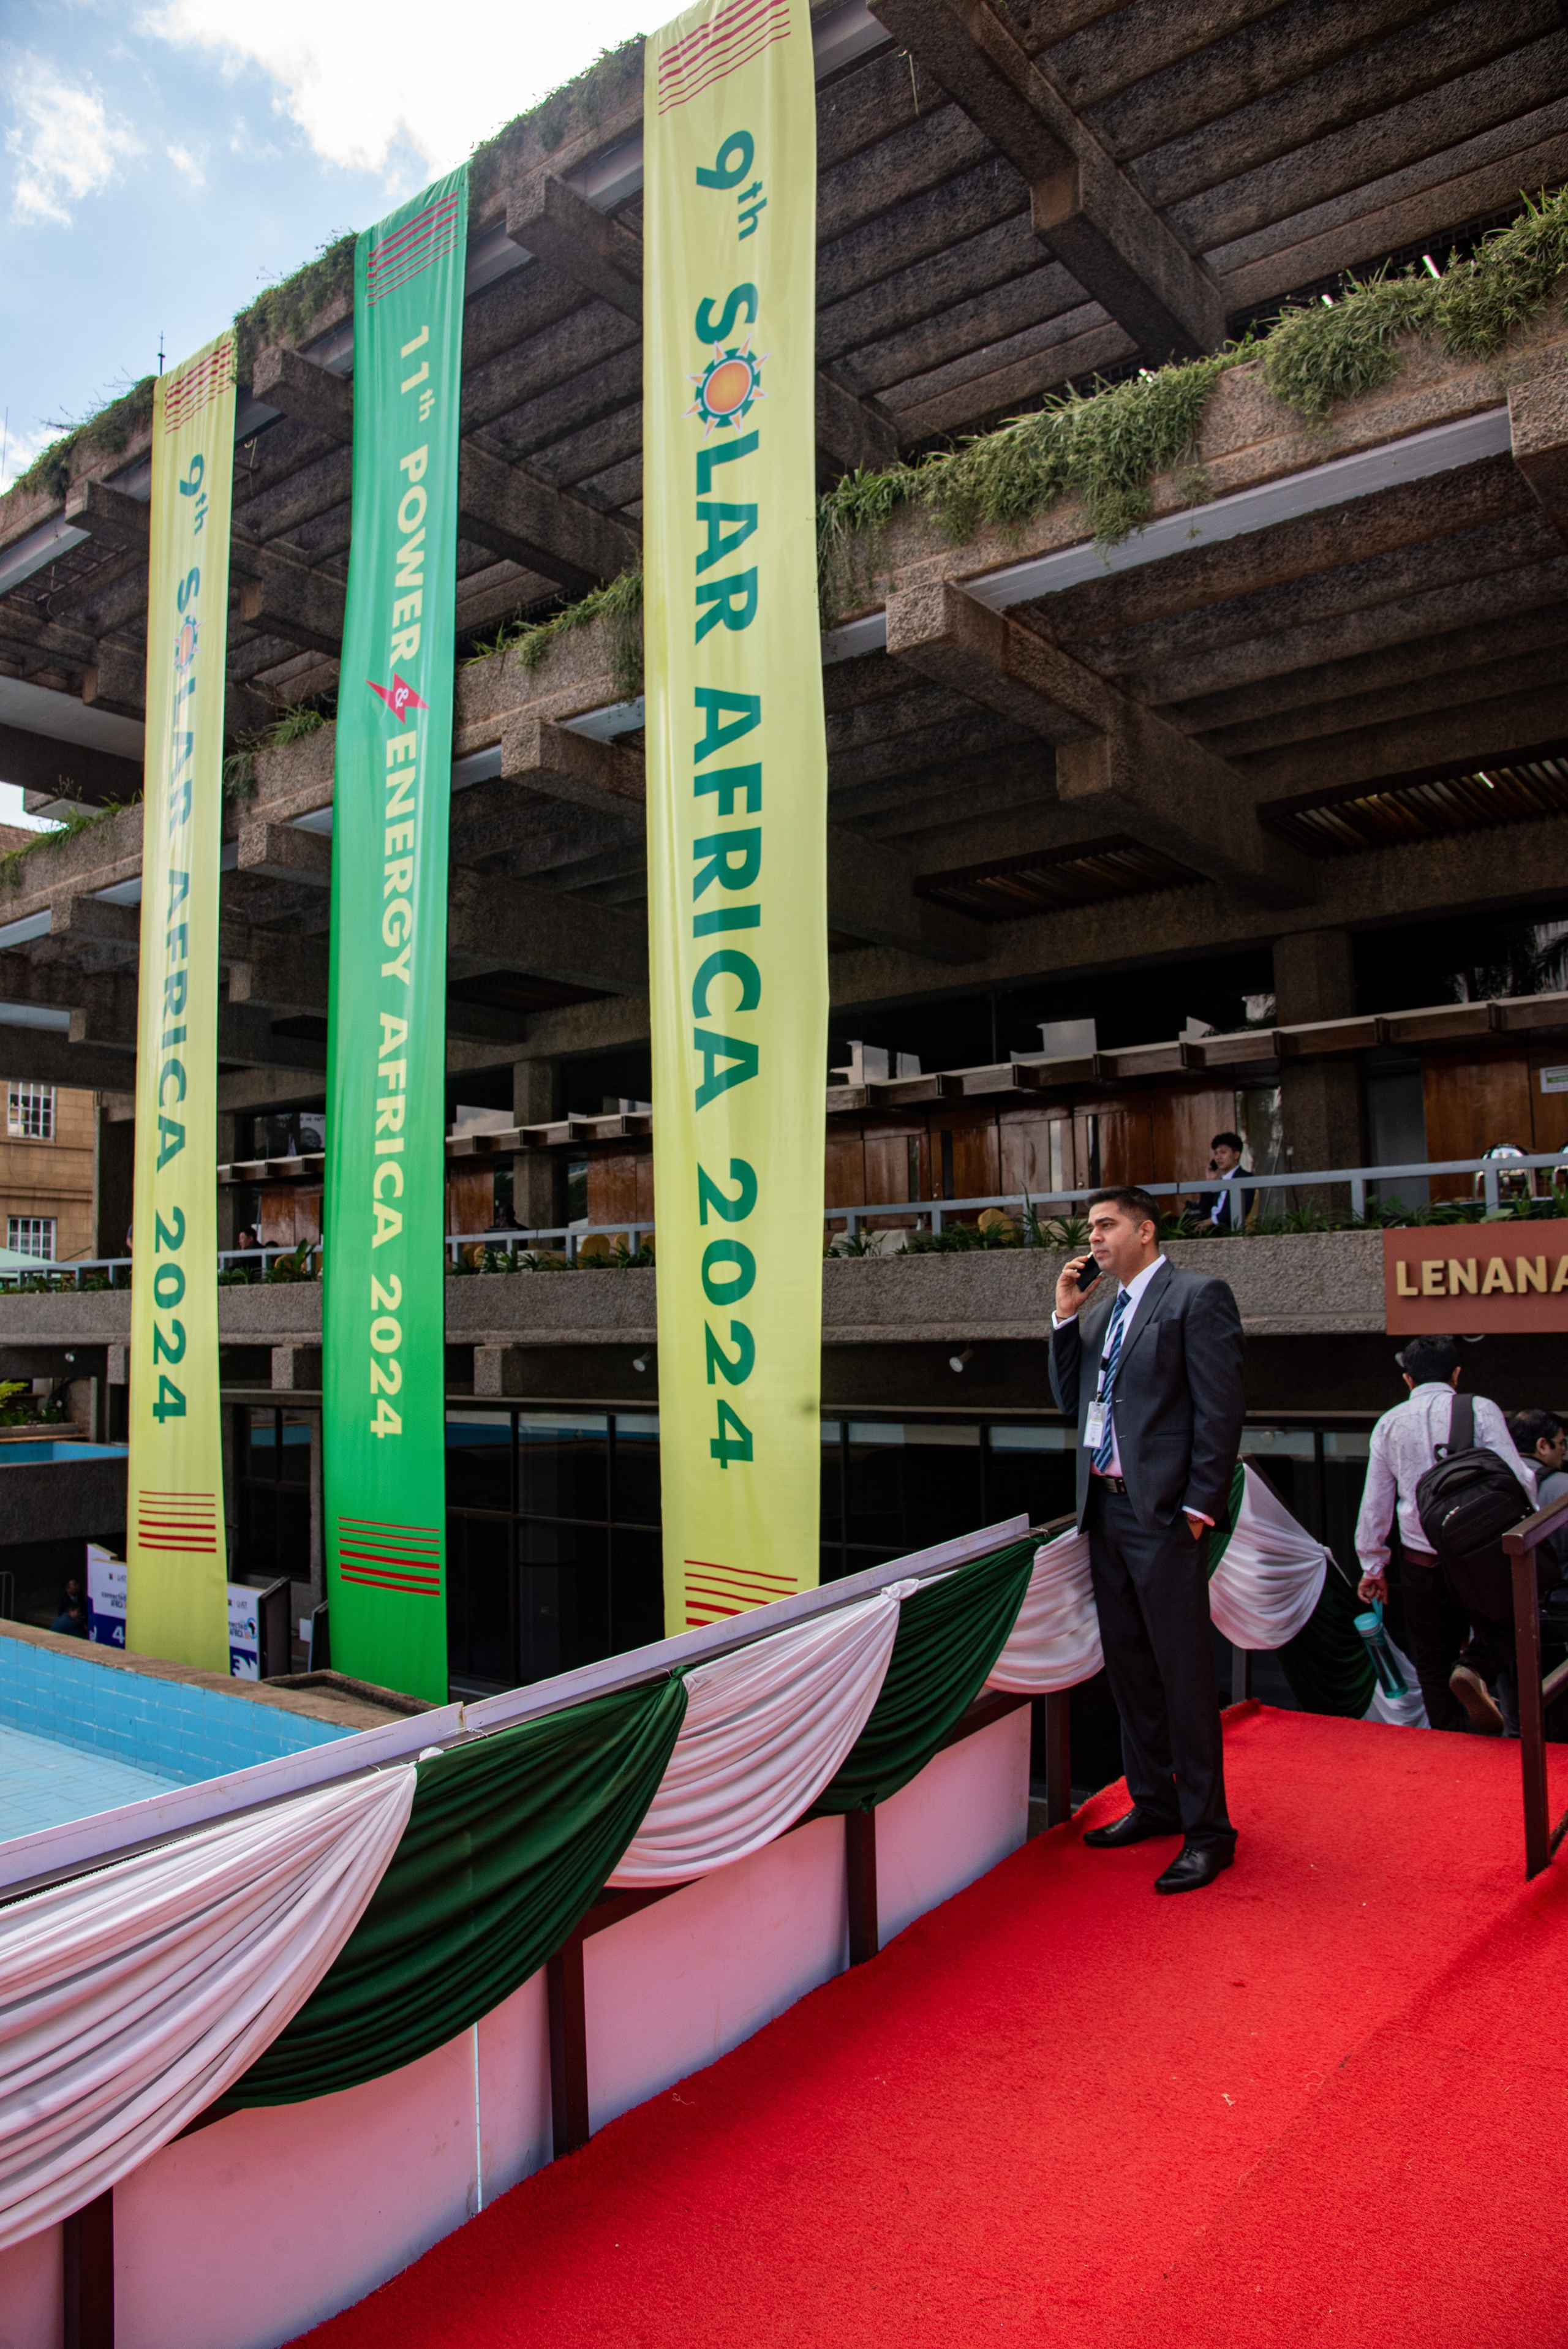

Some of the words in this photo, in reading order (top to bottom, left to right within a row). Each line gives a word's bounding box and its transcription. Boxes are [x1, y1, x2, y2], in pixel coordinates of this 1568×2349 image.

[696, 130, 767, 241] 9th
[400, 325, 435, 423] 11th
[695, 282, 761, 646] SOLAR
[179, 453, 208, 536] 9th
[389, 444, 429, 668] POWER
[169, 567, 200, 839] SOLAR
[394, 687, 409, 708] &
[381, 730, 417, 986] ENERGY
[693, 686, 762, 1113] AFRICA
[156, 867, 191, 1174] AFRICA
[372, 1012, 408, 1250] AFRICA
[152, 1205, 187, 1424] 2024
[370, 1273, 403, 1439] 2024
[697, 1158, 758, 1469] 2024
